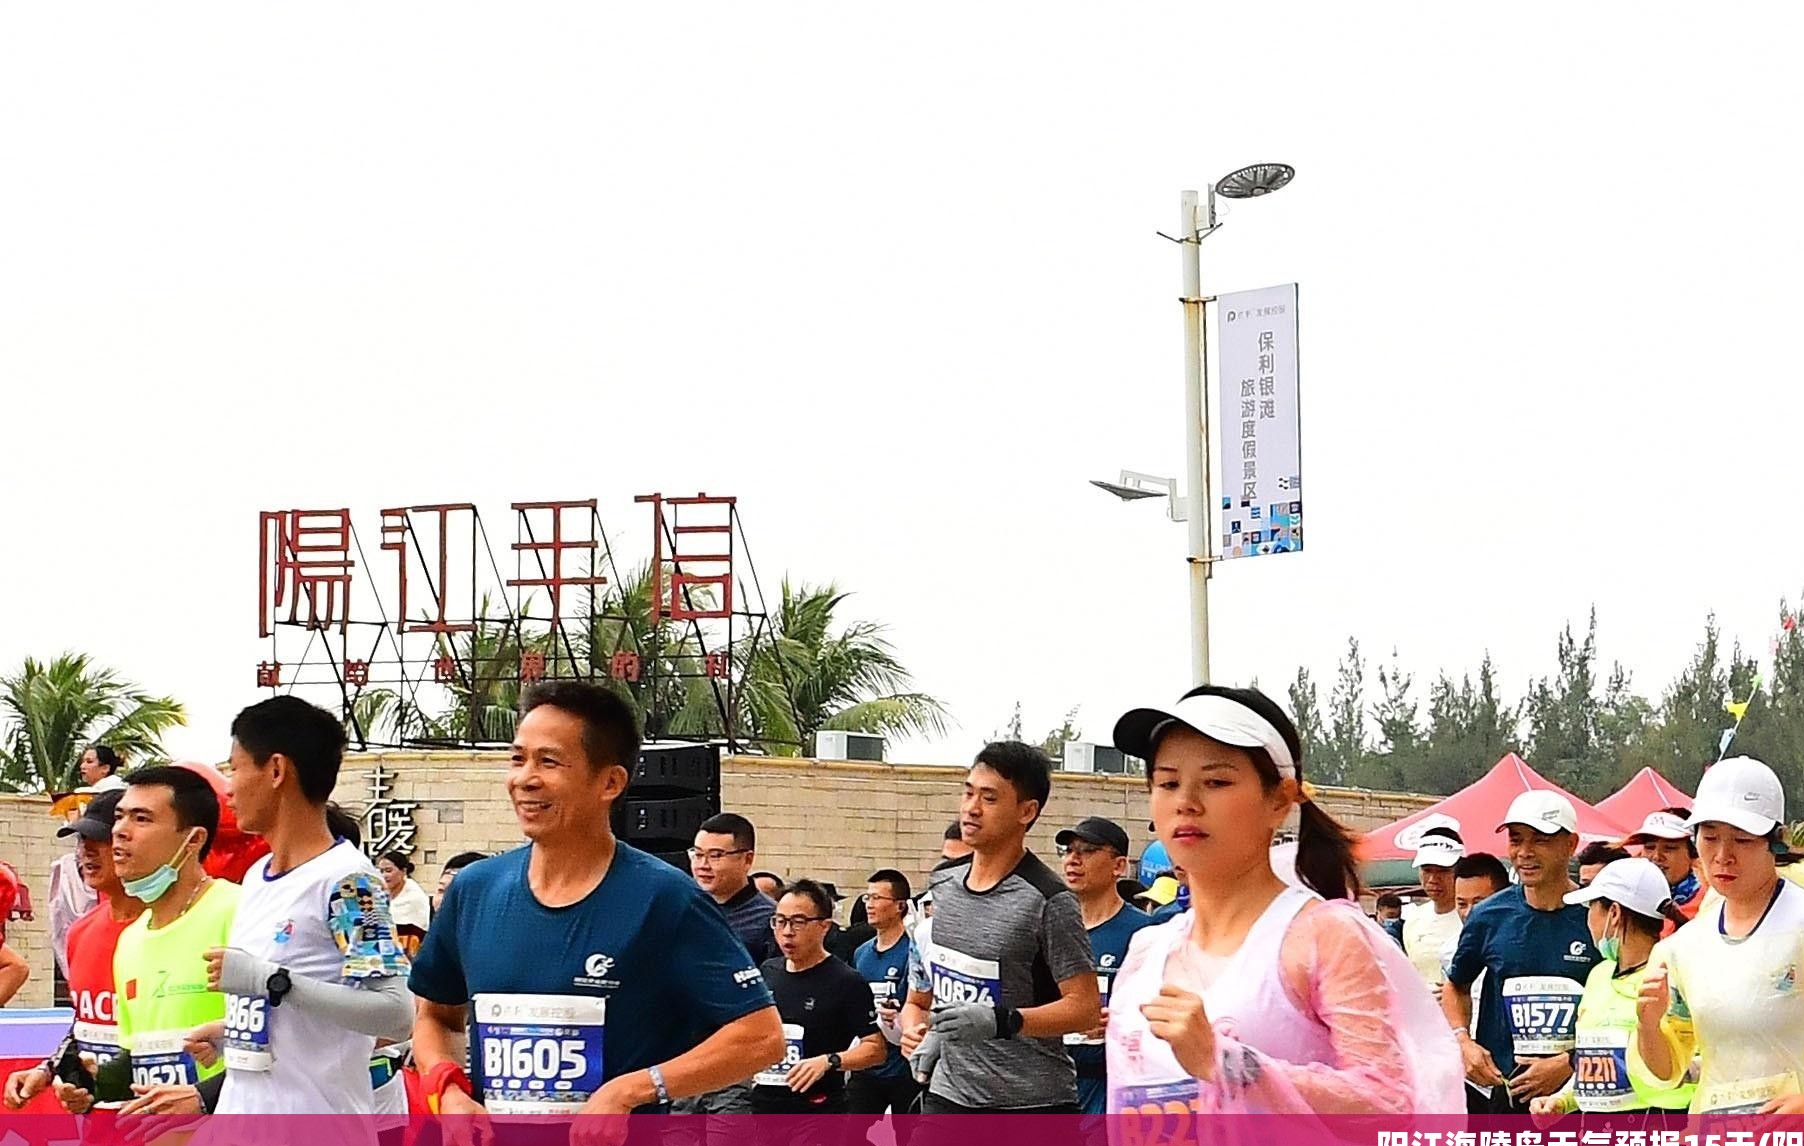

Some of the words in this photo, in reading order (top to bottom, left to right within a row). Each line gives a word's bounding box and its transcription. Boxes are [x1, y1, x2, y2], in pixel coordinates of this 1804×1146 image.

[1257, 331, 1275, 419] 保利银滩
[1510, 1002, 1576, 1028] B1577
[483, 1037, 588, 1080] B1605
